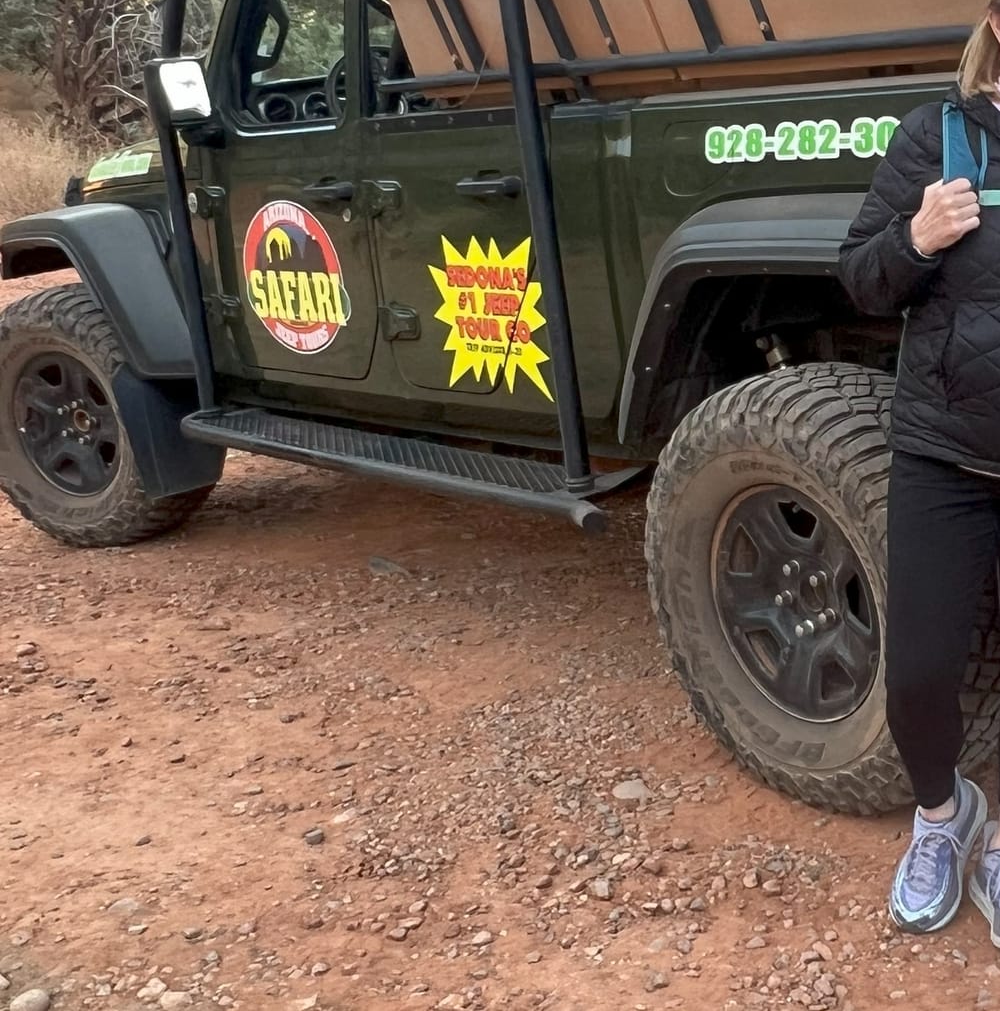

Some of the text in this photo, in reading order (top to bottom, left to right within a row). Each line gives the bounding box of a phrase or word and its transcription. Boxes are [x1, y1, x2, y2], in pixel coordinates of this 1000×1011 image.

[447, 265, 526, 291] SEDONA'S
[250, 270, 347, 326] SAFARI
[458, 291, 519, 317] #1 JEEP
[455, 316, 502, 342] TOUR
